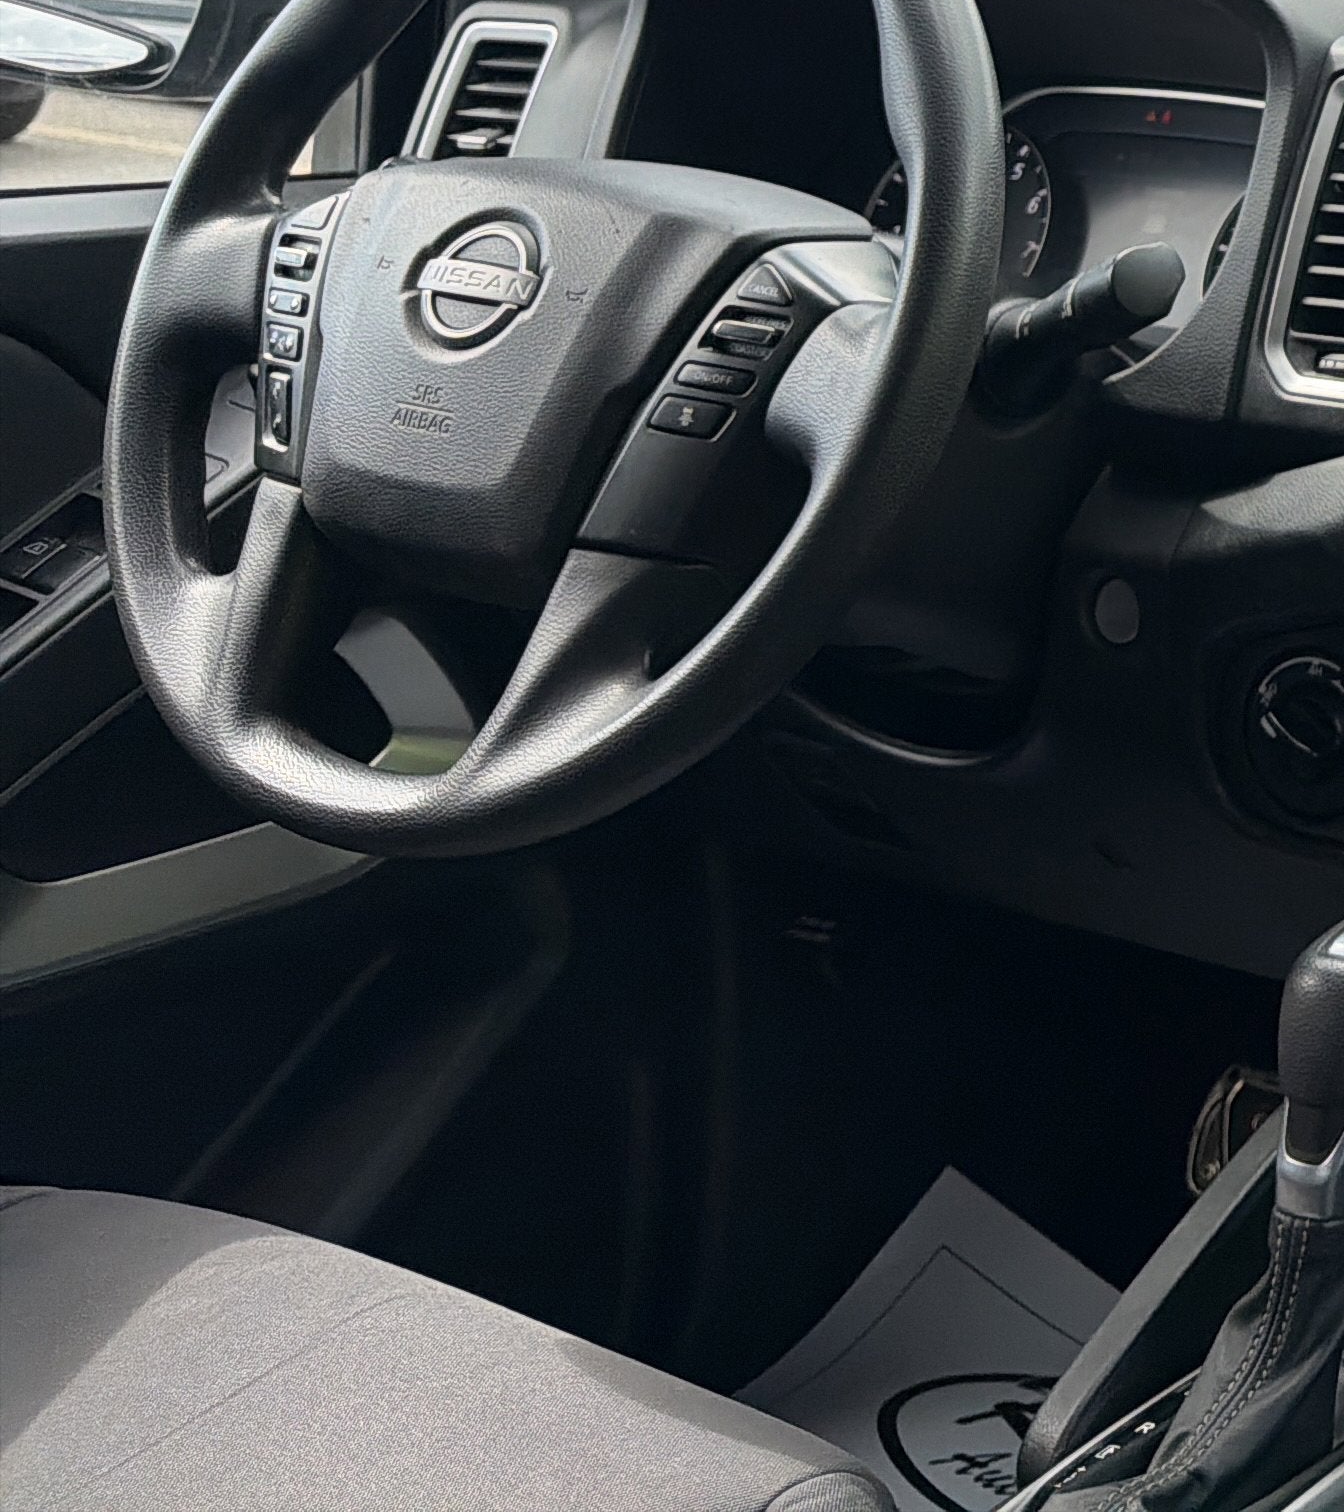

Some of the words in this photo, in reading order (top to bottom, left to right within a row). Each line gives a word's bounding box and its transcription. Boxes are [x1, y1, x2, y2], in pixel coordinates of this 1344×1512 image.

[422, 264, 533, 301] NISSAN
[411, 383, 444, 404] SRS
[391, 406, 452, 434] AIRBAG
